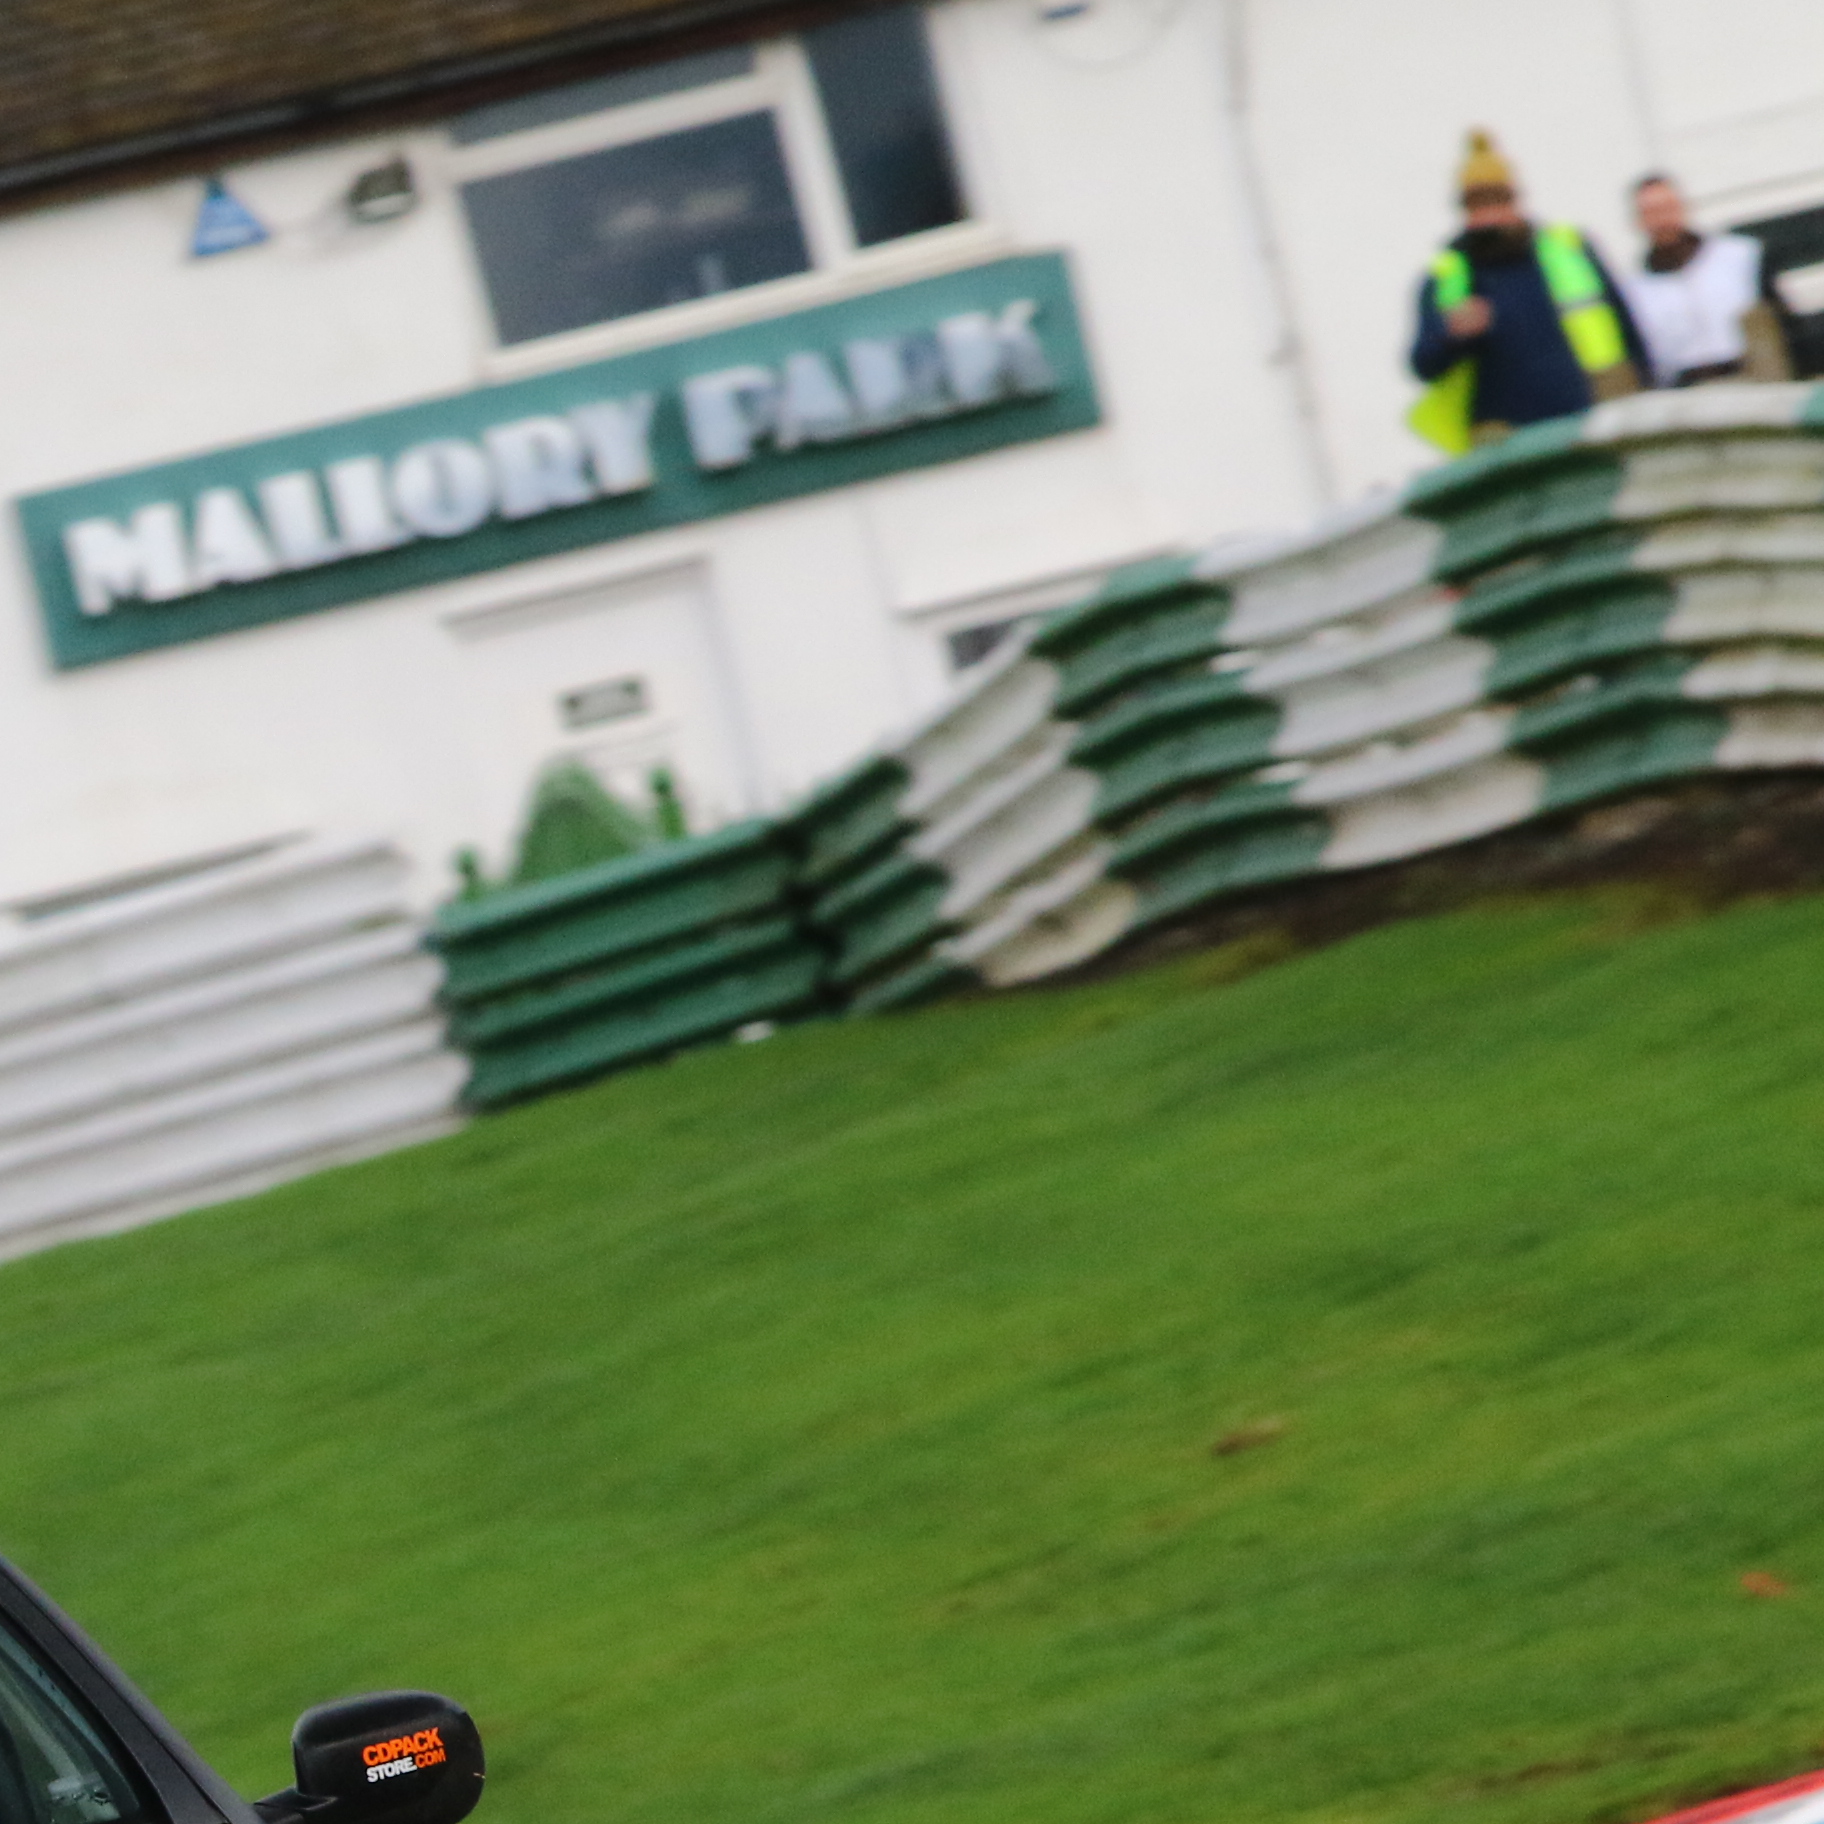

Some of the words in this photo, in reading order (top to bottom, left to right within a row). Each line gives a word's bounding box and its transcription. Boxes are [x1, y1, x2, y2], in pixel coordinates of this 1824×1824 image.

[63, 389, 660, 616] MALLORY
[678, 296, 1067, 476] PARK
[363, 1727, 444, 1766] CDPACK
